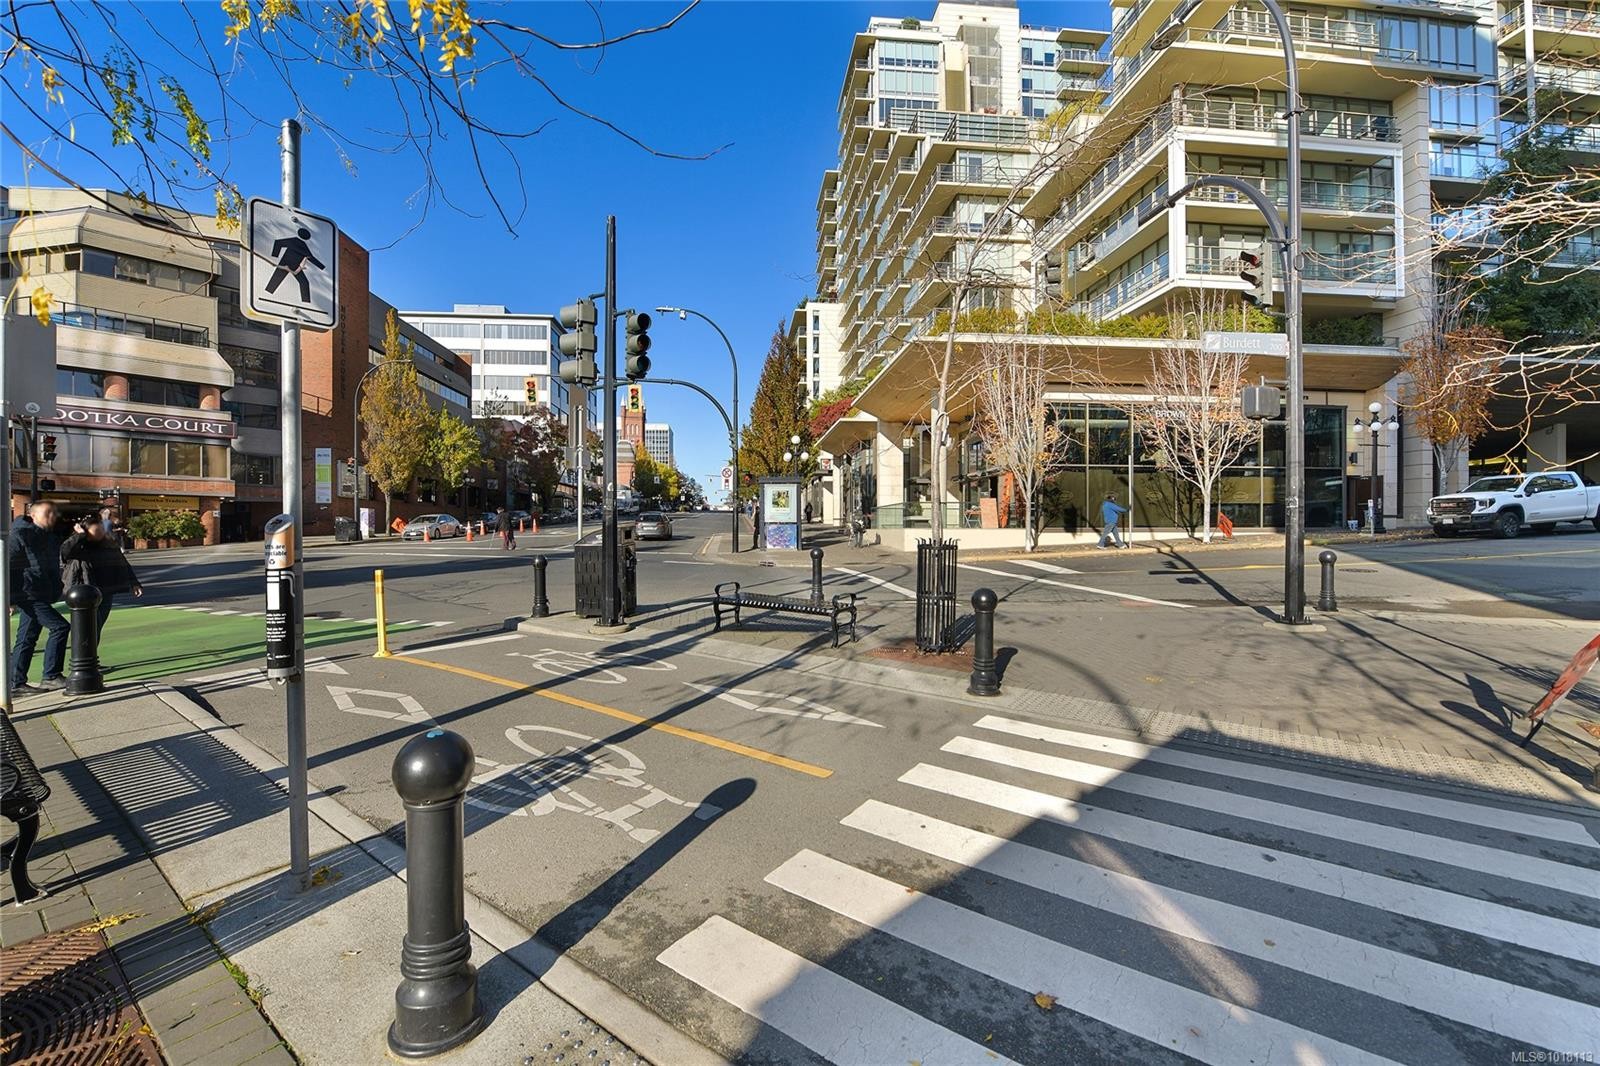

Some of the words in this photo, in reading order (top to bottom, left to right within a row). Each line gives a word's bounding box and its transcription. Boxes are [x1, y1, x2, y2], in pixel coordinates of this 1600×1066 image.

[1223, 337, 1261, 349] Burdett
[53, 408, 140, 427] OOTKA
[146, 417, 228, 434] COURT
